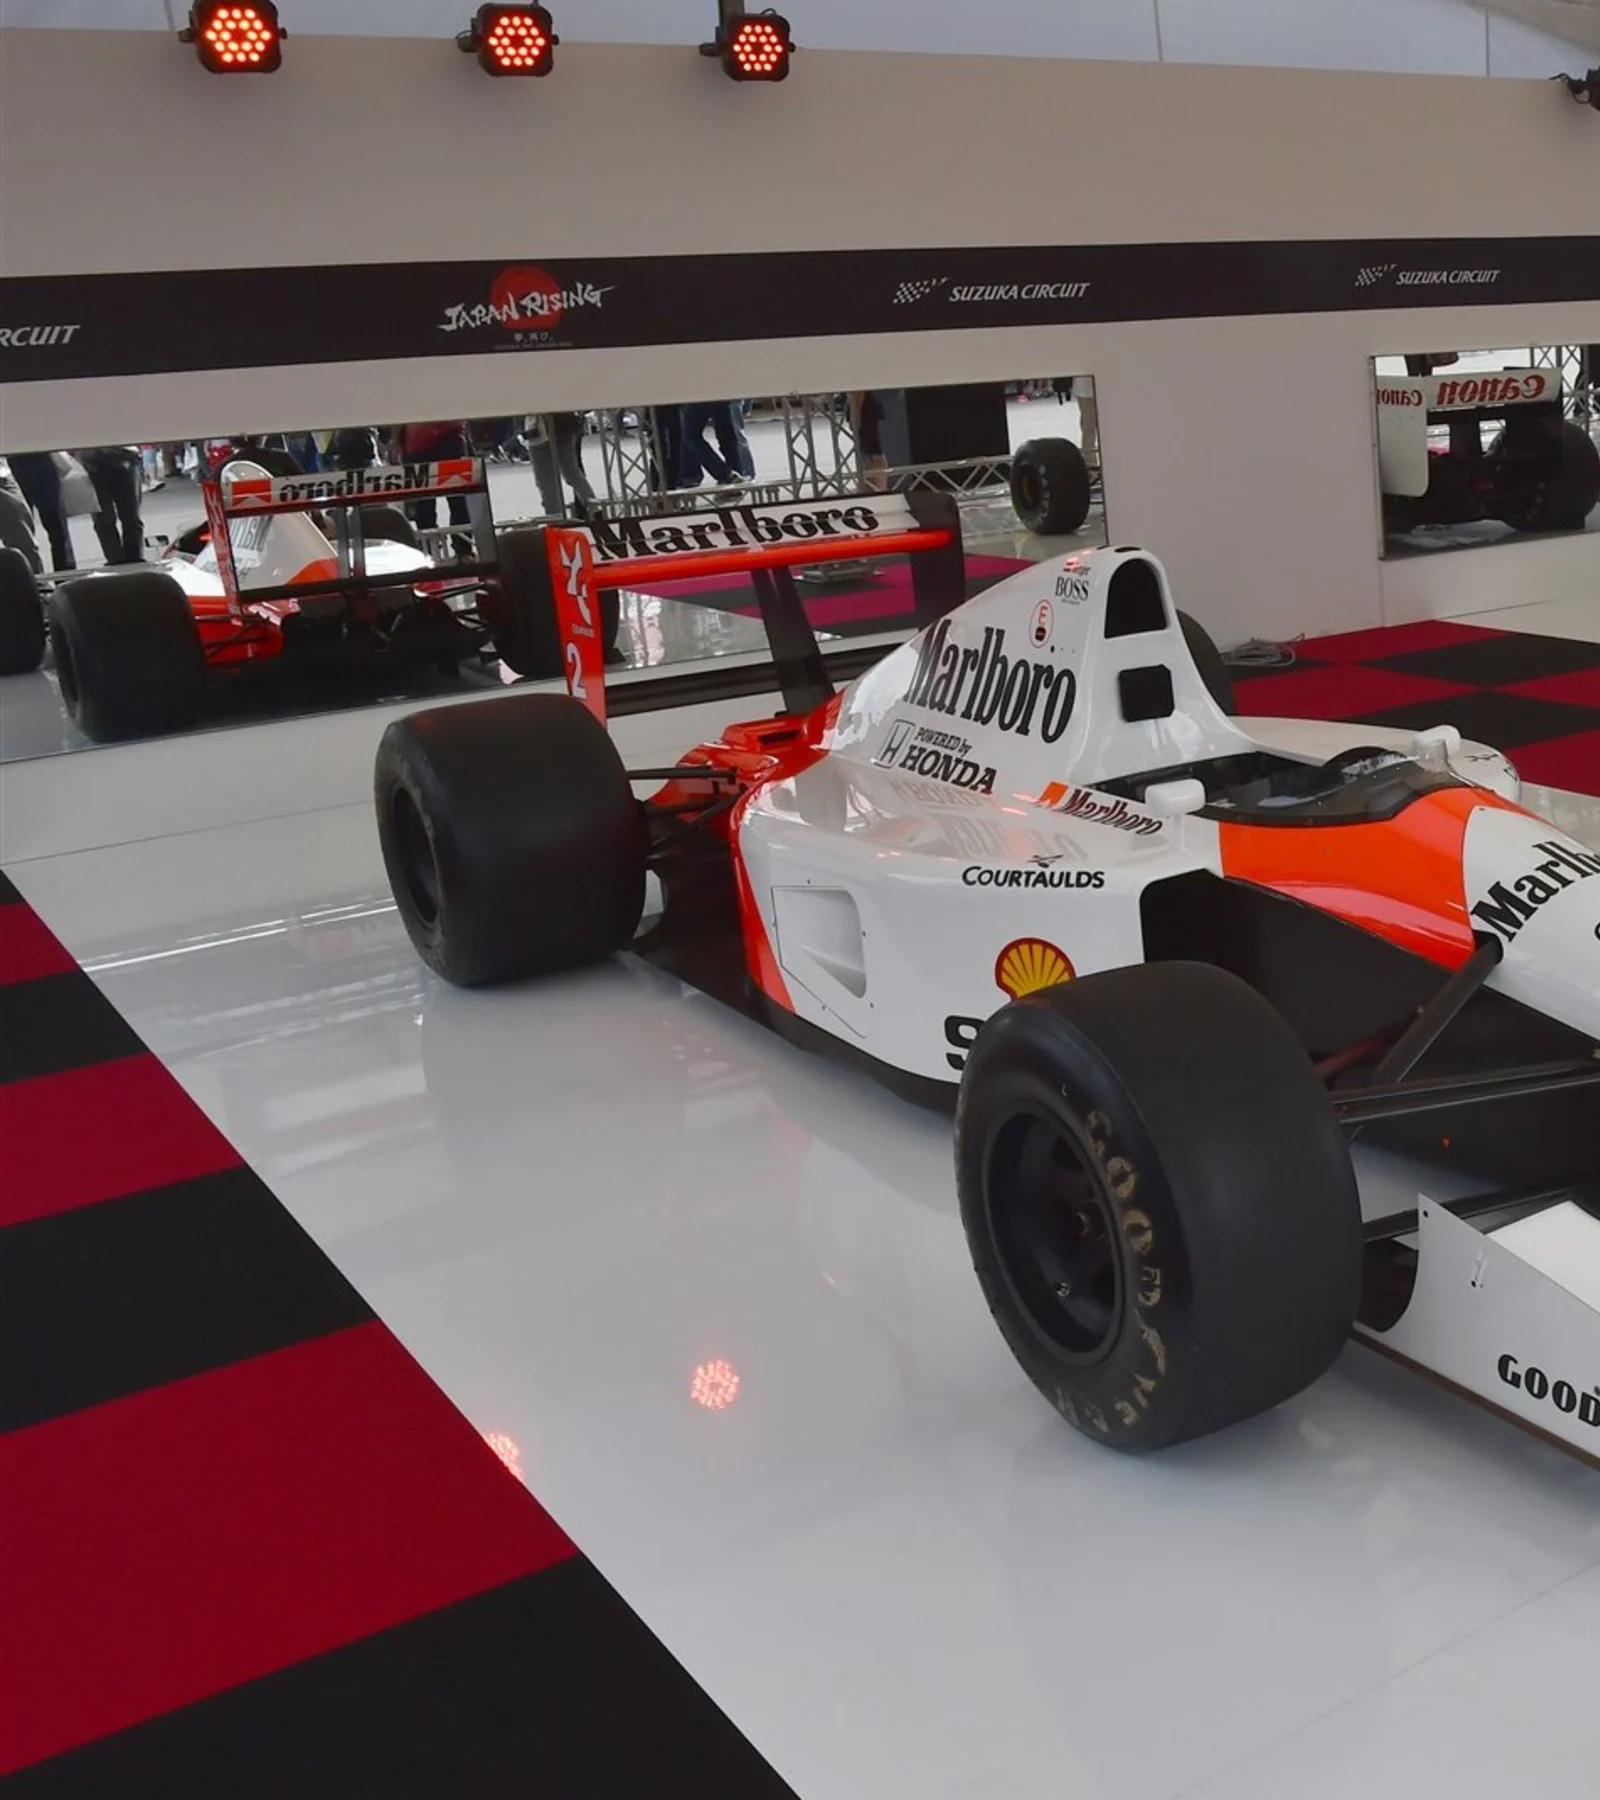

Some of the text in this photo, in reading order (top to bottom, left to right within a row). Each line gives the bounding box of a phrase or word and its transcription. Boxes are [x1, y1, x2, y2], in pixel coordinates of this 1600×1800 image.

[950, 283, 1089, 302] SUZUKA CIRCUIT
[1395, 269, 1500, 285] SUZUKA CIRCUIT
[437, 281, 617, 332] JAPAN RISING
[0, 324, 80, 347] RCUIT
[589, 505, 880, 562] Marlboro
[1055, 576, 1090, 602] BOSS
[565, 642, 588, 700] 2
[903, 618, 1077, 745] Marlboro
[914, 727, 973, 755] POWERED by
[899, 743, 998, 796] HONDA
[1063, 788, 1163, 836] Marlboro
[962, 866, 1106, 889] COURTAULDS
